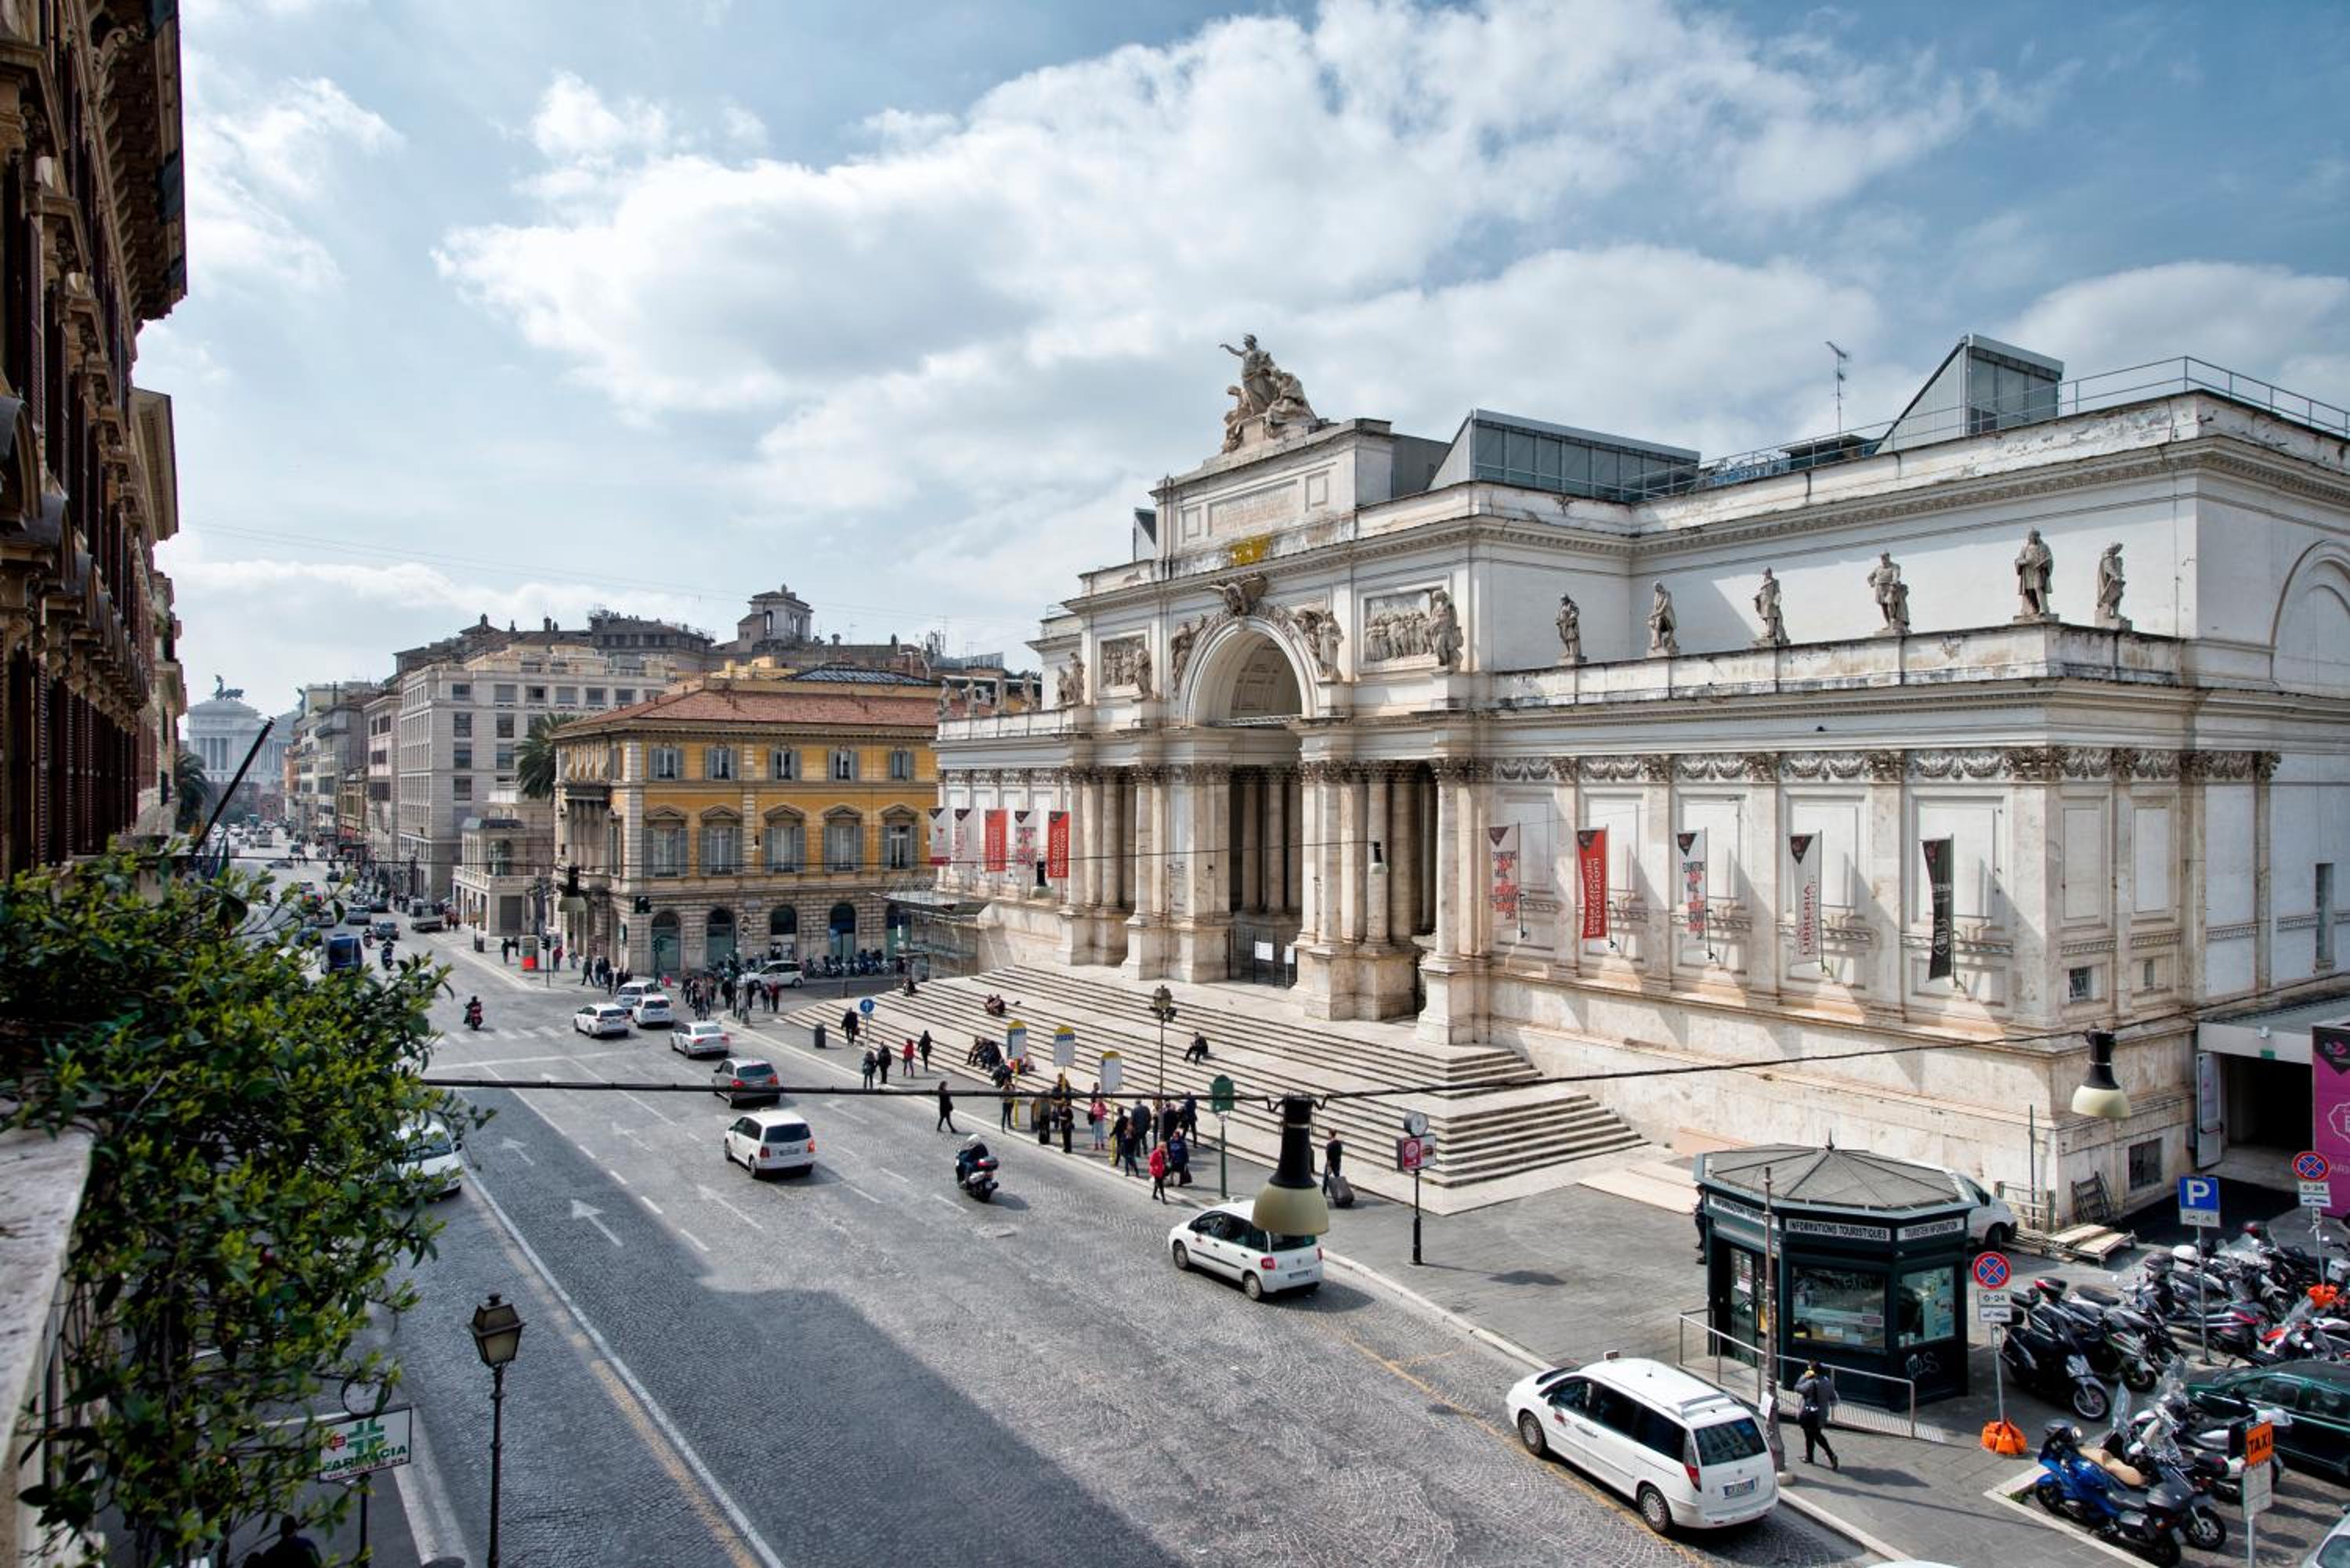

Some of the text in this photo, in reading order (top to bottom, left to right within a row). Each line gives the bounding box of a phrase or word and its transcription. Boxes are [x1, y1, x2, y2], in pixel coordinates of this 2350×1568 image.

[2187, 1180, 2210, 1205] P
[1789, 1221, 1887, 1240] INFORMATIONS TOURISTIQUES
[2248, 1432, 2271, 1455] TAXI
